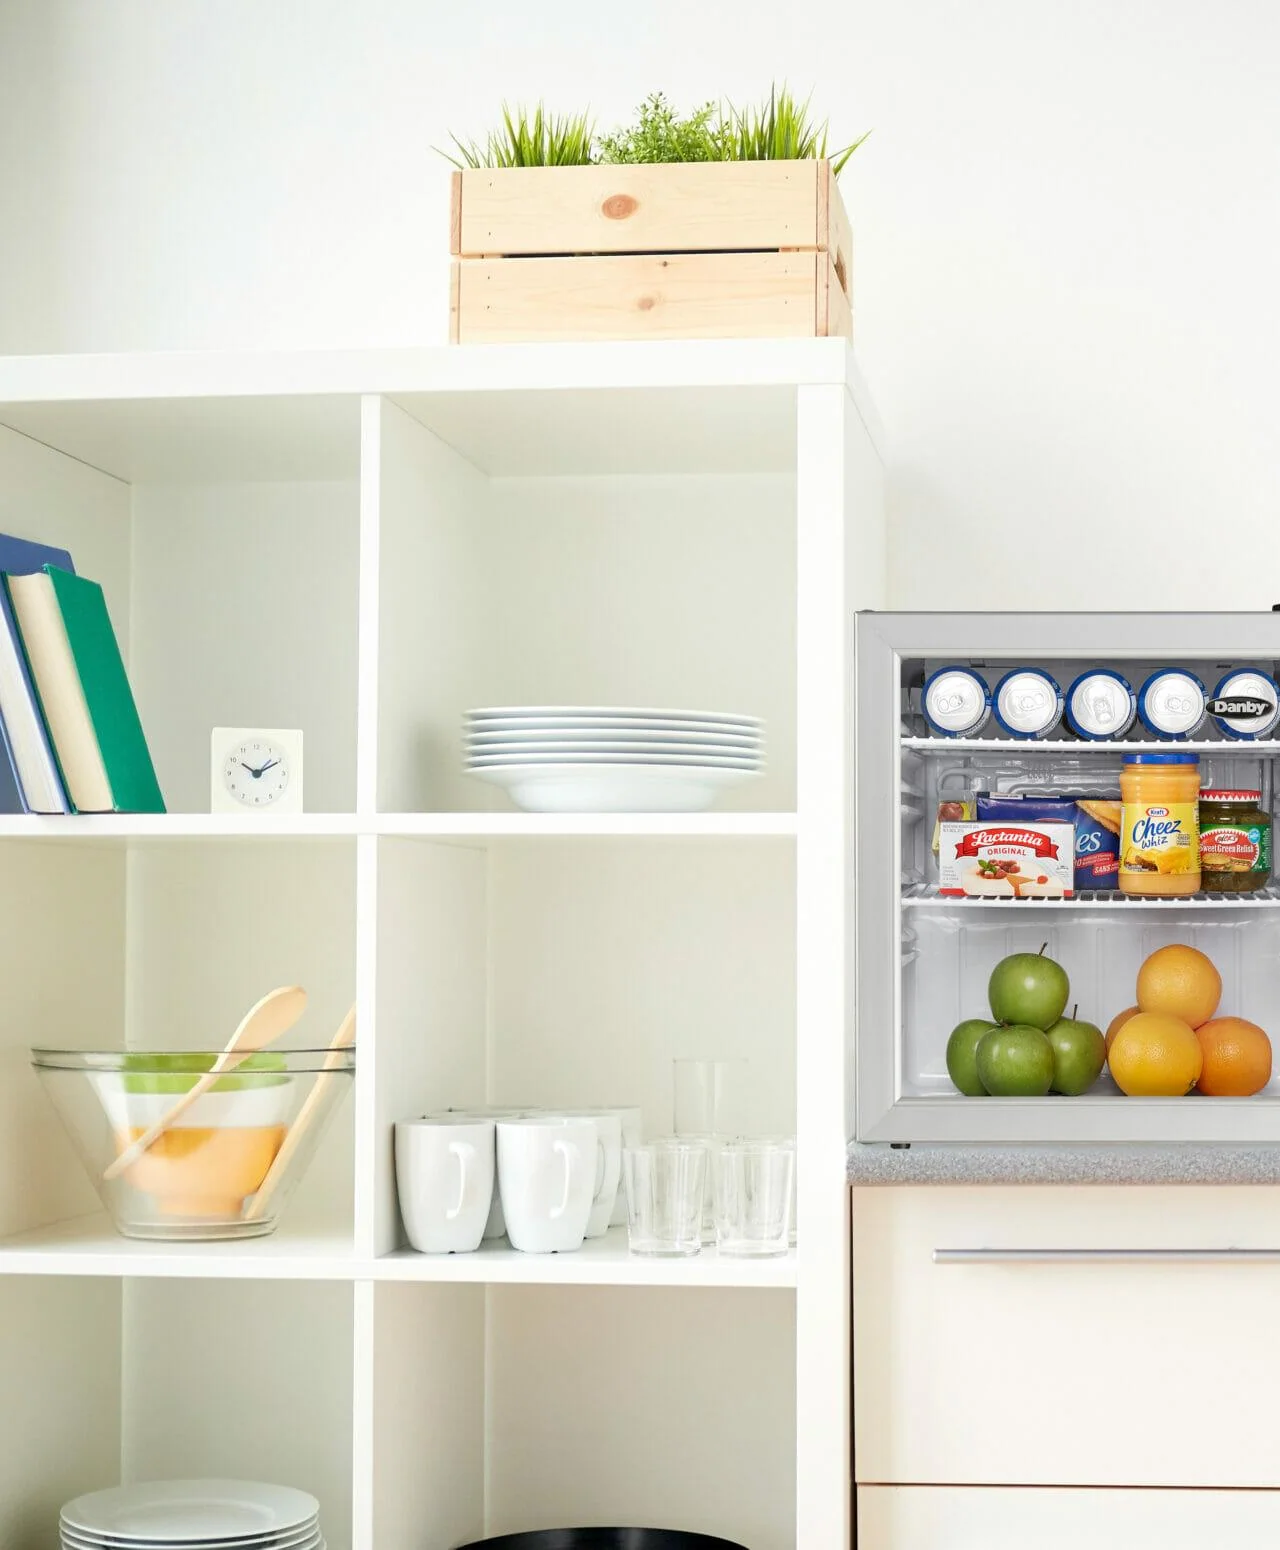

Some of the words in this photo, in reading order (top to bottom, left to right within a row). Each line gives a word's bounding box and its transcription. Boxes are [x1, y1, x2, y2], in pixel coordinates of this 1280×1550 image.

[1214, 701, 1265, 715] Danby
[1132, 816, 1182, 843] Cheez
[971, 830, 1044, 846] Lactantia
[1075, 831, 1102, 852] es
[987, 847, 1027, 856] ORIGINAL
[1217, 844, 1235, 853] Green
[1236, 844, 1254, 853] Relish
